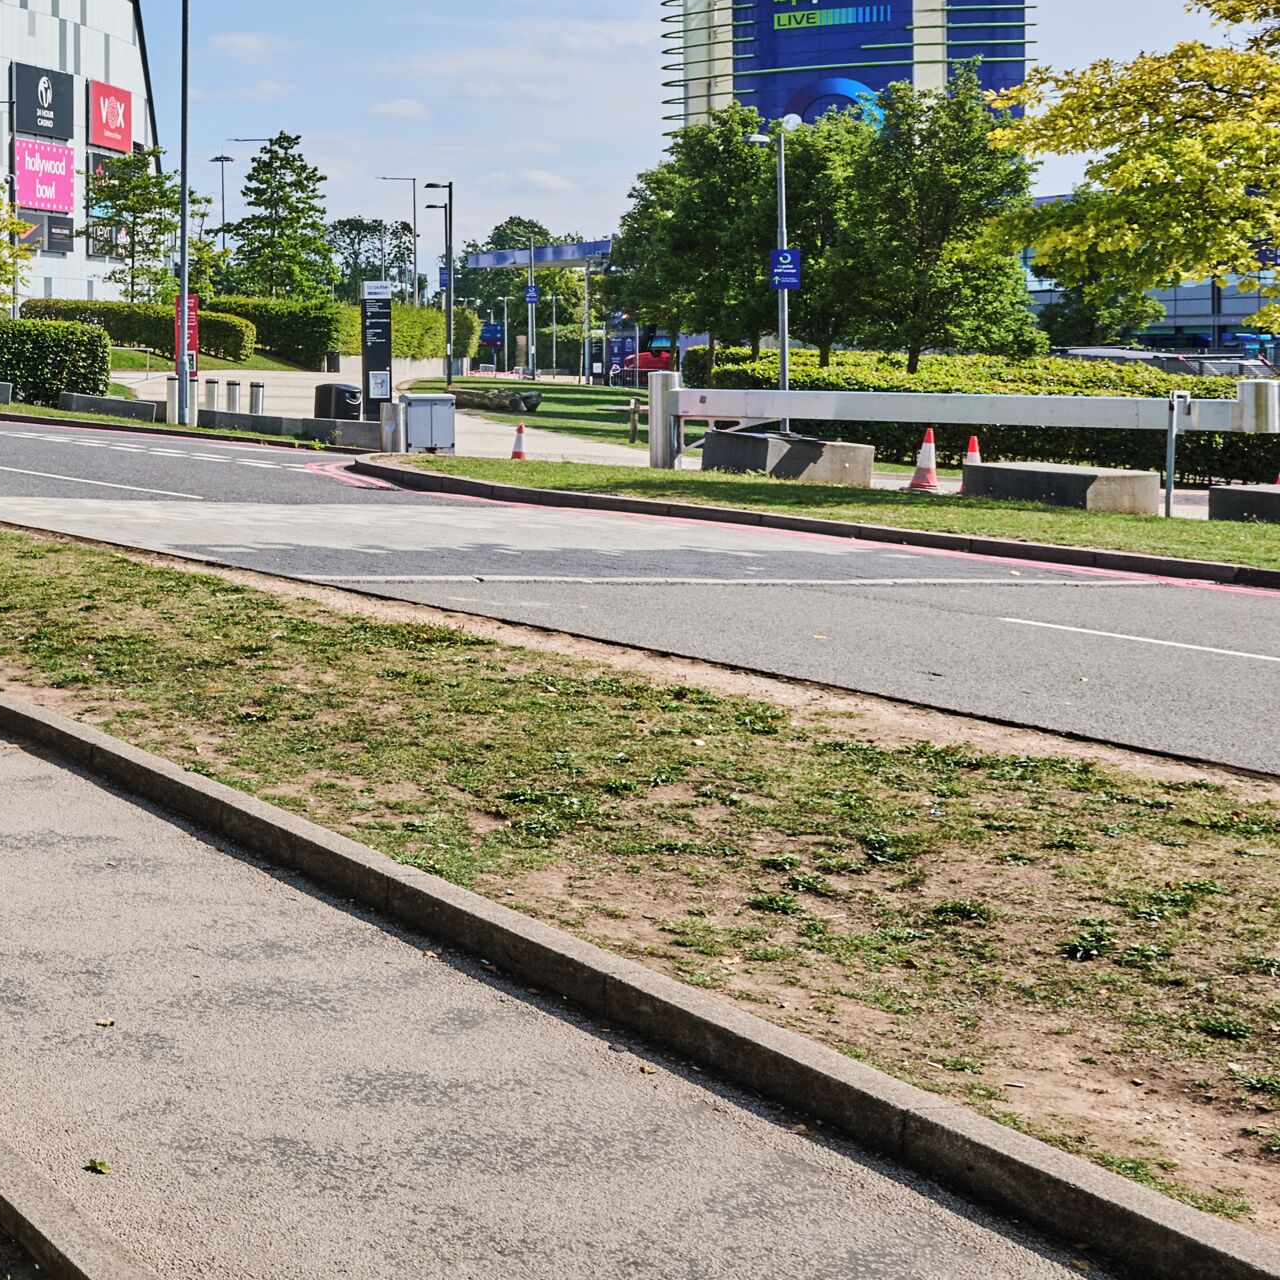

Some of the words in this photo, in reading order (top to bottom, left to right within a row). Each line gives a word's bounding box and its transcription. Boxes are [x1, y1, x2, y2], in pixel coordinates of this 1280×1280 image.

[777, 12, 818, 27] LIVE
[25, 151, 66, 177] hollywood
[35, 180, 56, 200] bowl
